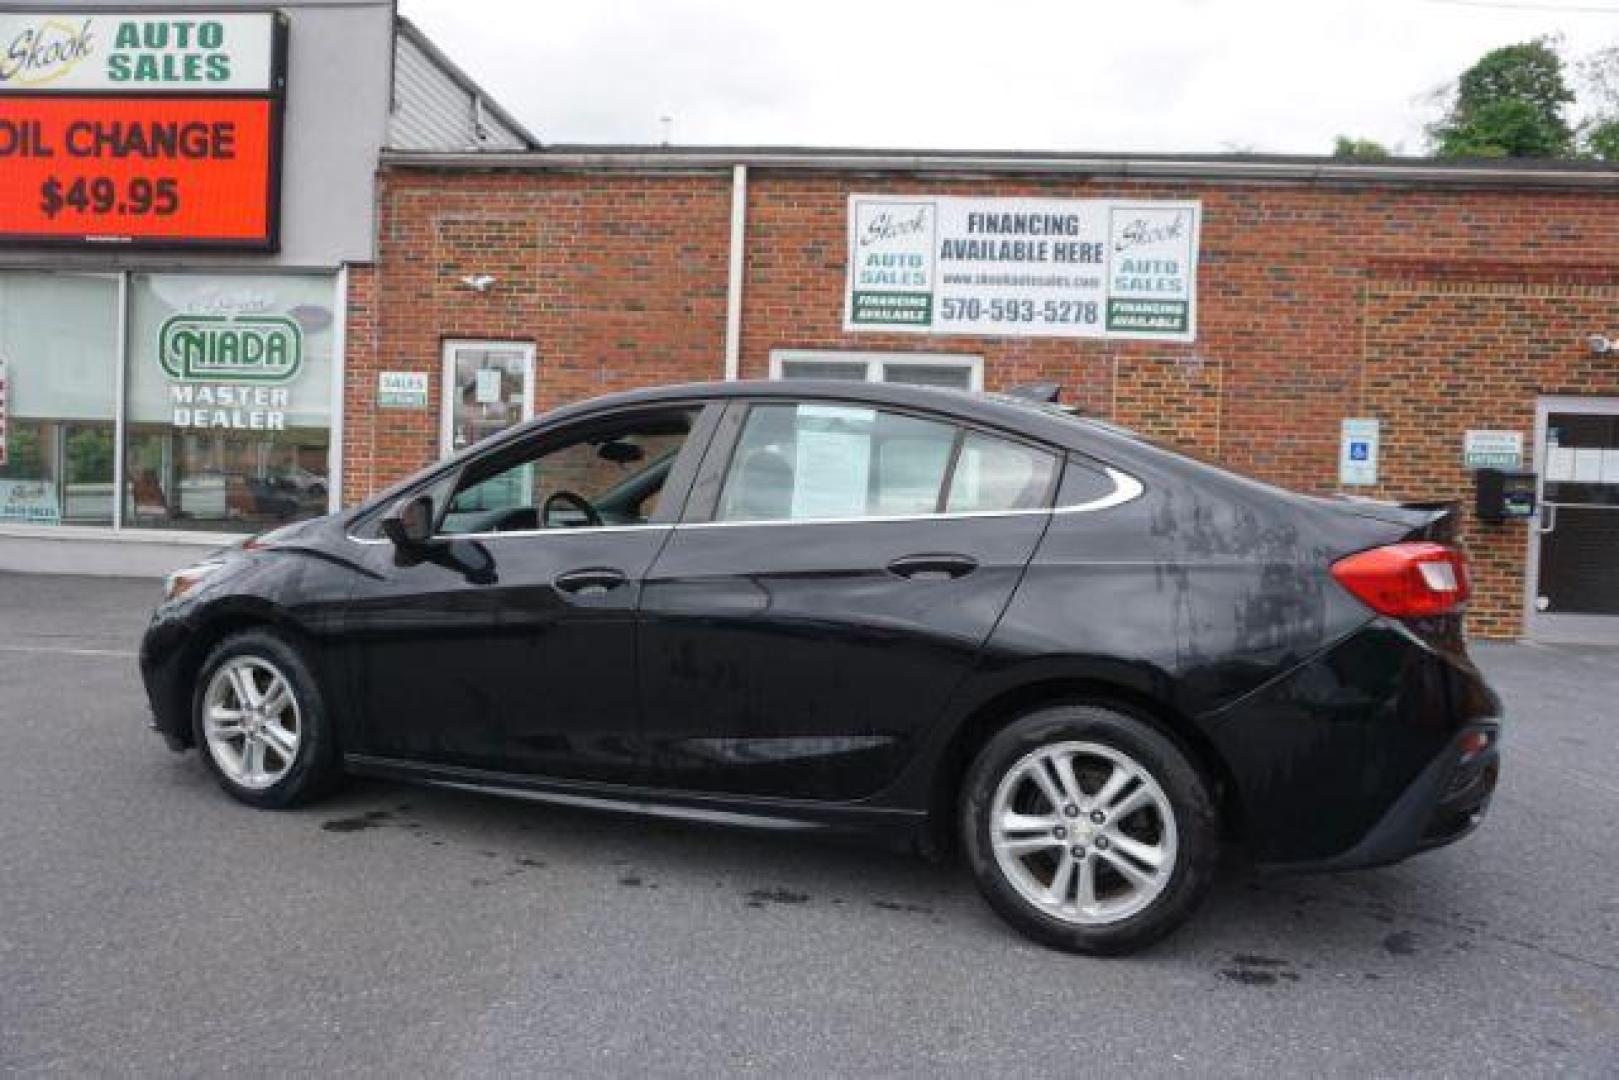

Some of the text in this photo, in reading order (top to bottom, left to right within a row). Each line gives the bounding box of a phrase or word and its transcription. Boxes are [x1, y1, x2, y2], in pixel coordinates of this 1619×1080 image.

[115, 21, 224, 49] AUTO
[107, 53, 231, 82] SALES
[0, 119, 235, 159] OIL CHANGE
[40, 174, 178, 219] $49.95
[968, 212, 1078, 236] FINANCING
[865, 252, 924, 267] AUTO
[941, 239, 1104, 264] AVAILABLE HERE
[860, 270, 927, 286] SALES
[1120, 260, 1180, 274] AUTO
[1115, 277, 1183, 292] SALES
[942, 298, 1100, 325] 570-593-5278
[171, 386, 288, 406] MASTER
[173, 409, 287, 431] DEALER
